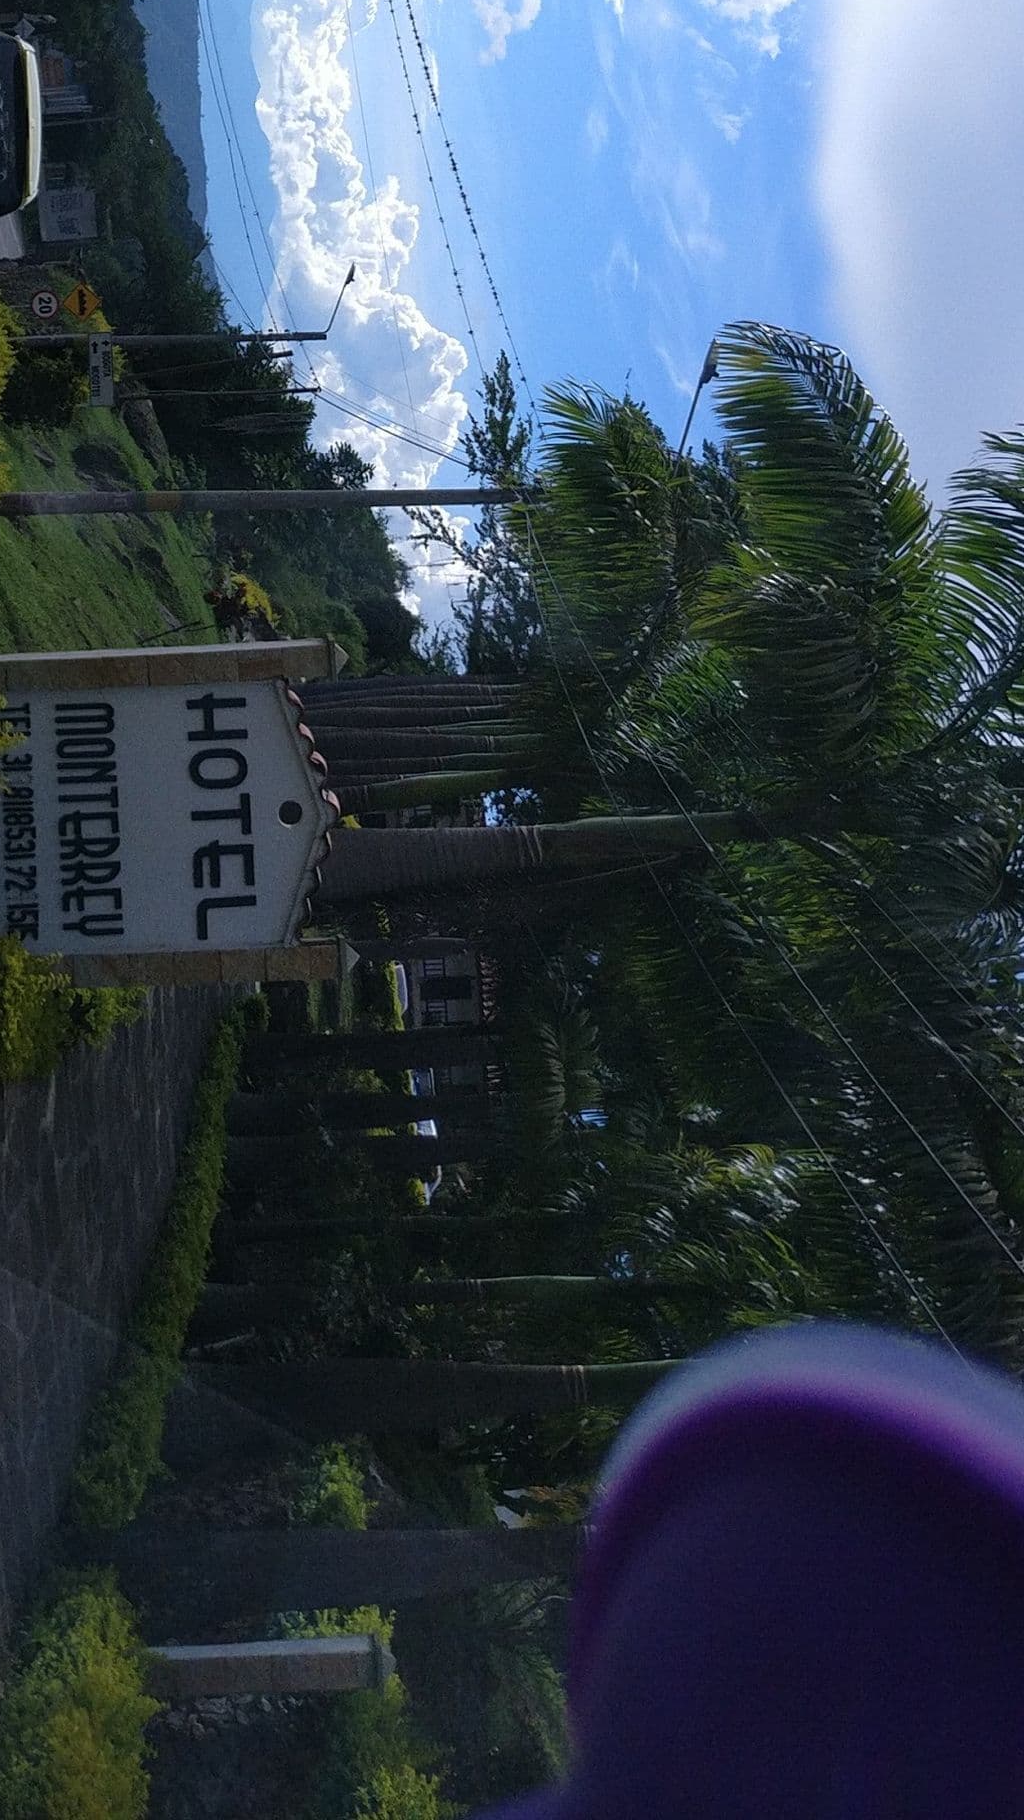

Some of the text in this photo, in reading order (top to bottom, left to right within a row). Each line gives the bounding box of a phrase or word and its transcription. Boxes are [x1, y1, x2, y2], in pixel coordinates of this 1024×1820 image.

[39, 296, 52, 314] 20
[55, 702, 124, 937] MONTERREY
[185, 692, 257, 941] HOTEL
